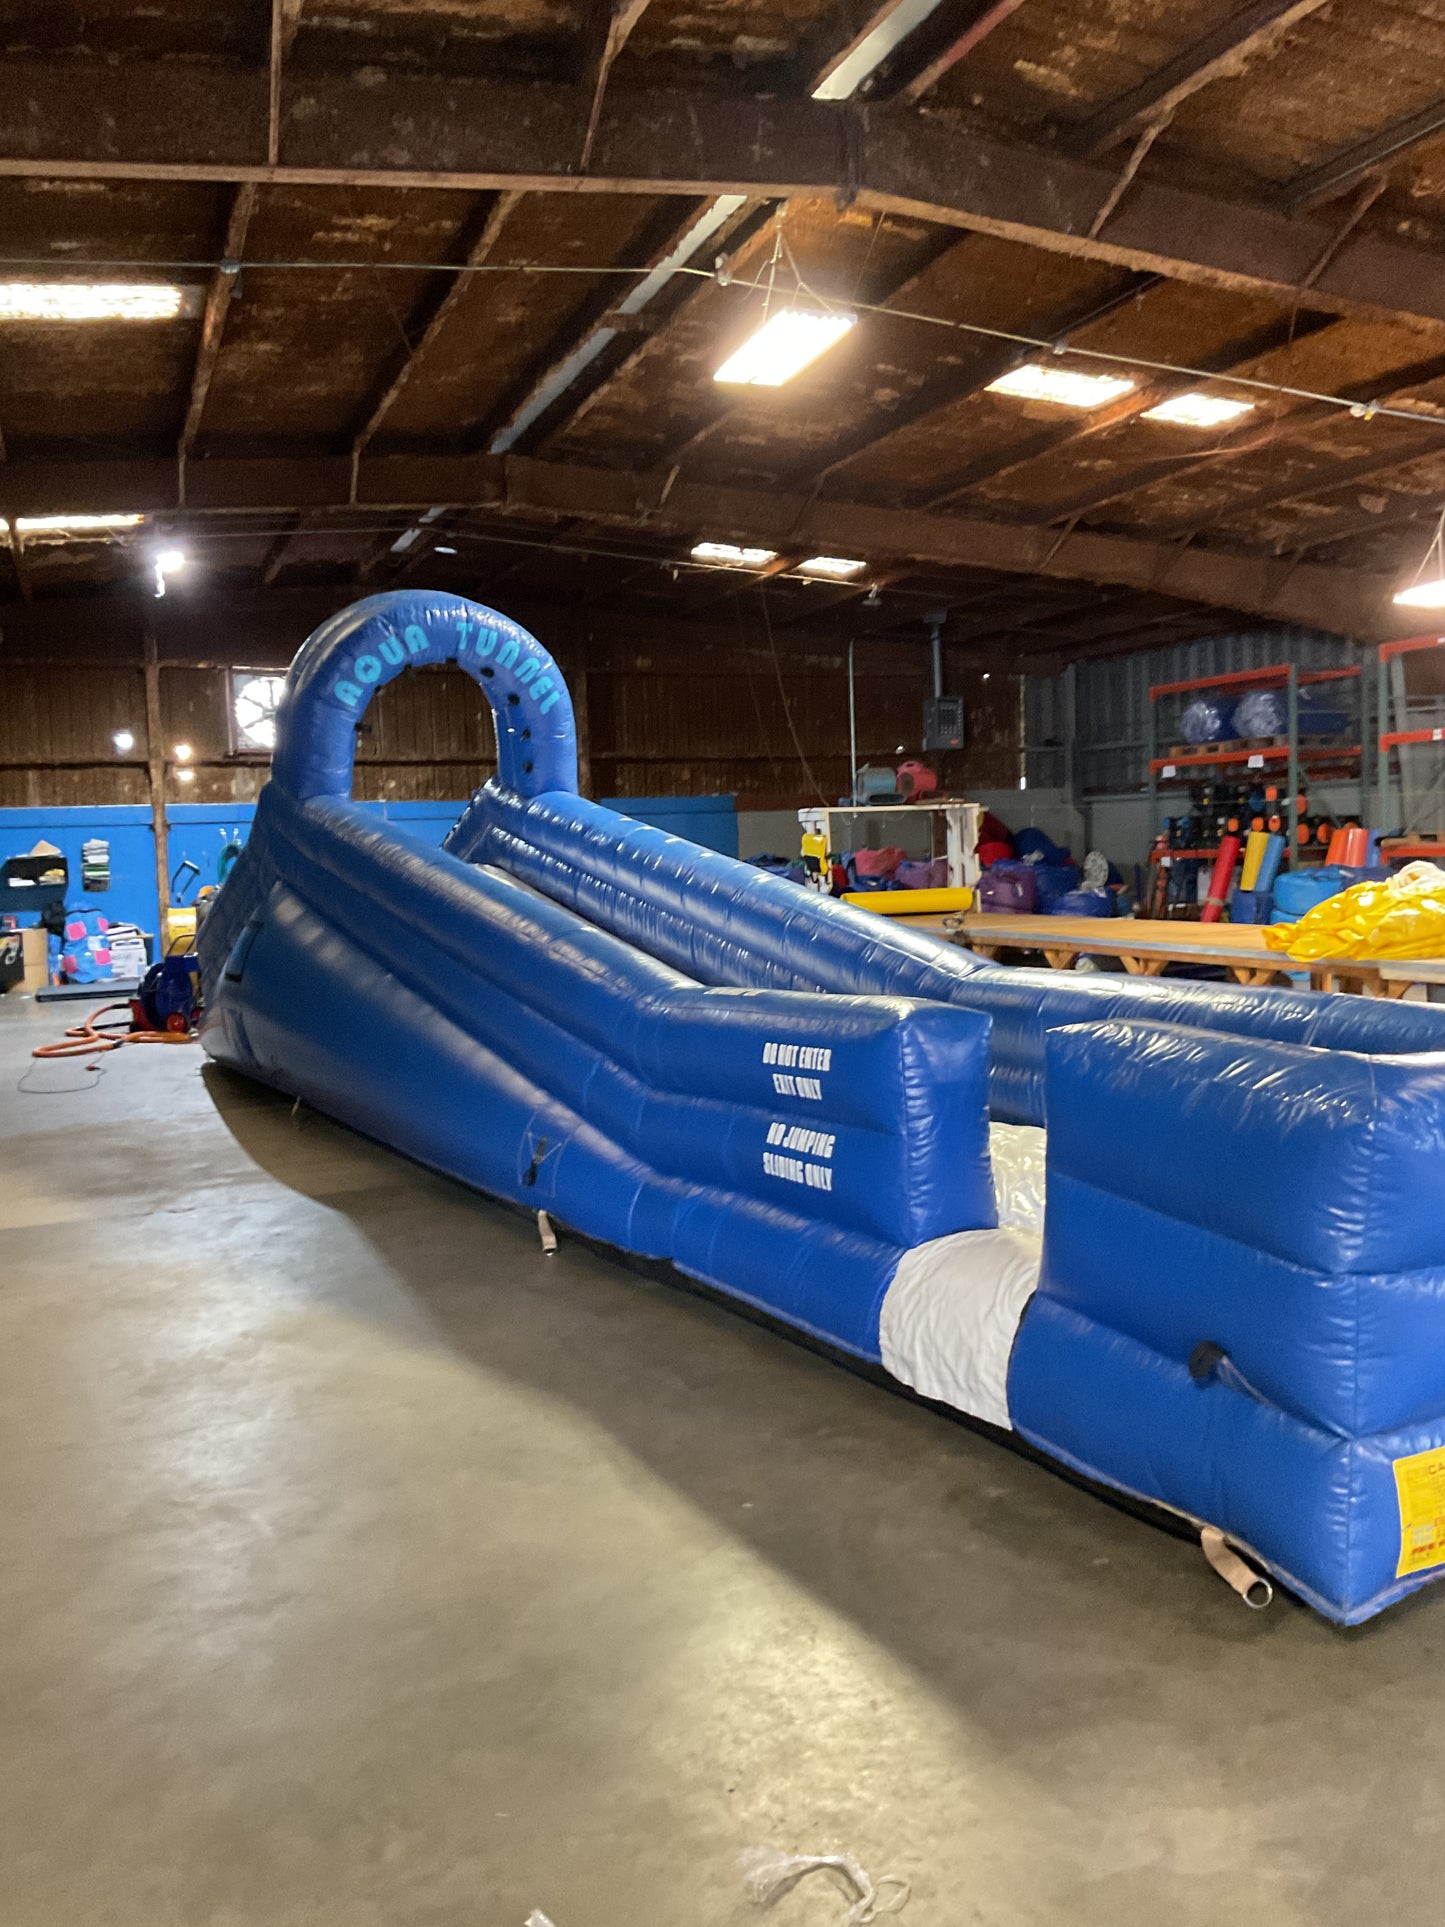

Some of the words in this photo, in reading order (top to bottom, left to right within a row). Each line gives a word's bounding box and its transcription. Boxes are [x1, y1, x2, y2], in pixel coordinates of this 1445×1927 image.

[334, 624, 430, 707] AQUA
[456, 622, 561, 714] TUNNEL
[778, 1044, 799, 1067] NOT
[799, 1046, 832, 1071] ENTER
[773, 1073, 797, 1096] EXIT
[766, 1122, 786, 1145] NO
[782, 1126, 836, 1158] JUMPING
[763, 1152, 804, 1183] SLIDING
[805, 1163, 832, 1191] ONLY
